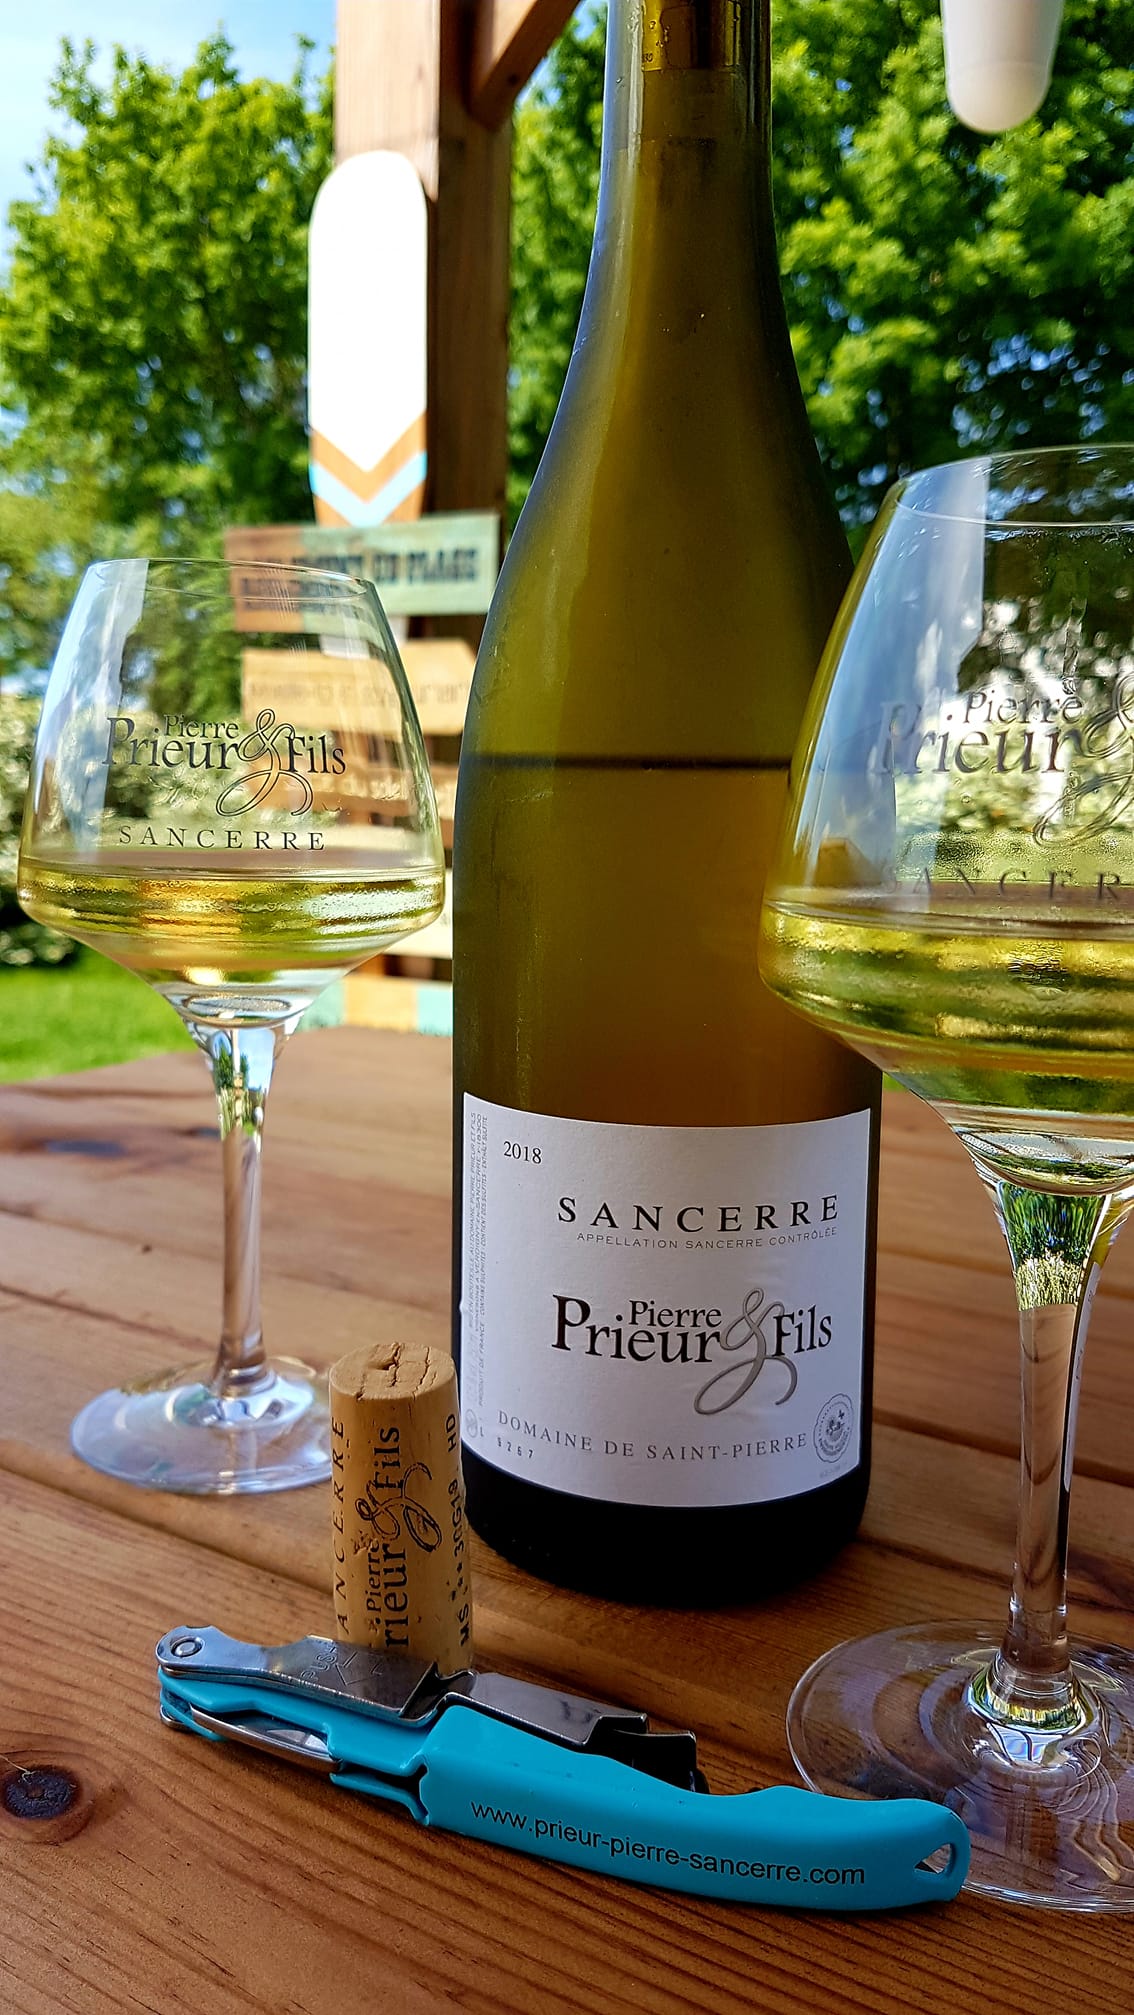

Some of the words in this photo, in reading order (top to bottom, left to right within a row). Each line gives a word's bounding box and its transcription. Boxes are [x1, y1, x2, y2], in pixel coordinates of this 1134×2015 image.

[164, 714, 239, 738] Pierre
[963, 689, 1083, 724] Pierre
[102, 717, 239, 769] Prieur
[216, 708, 313, 817] &
[285, 735, 346, 774] Fils
[119, 826, 325, 850] SANCERRE
[503, 1141, 542, 1164] 2018
[558, 1195, 838, 1233] SANCERRE
[577, 1232, 677, 1249] APPELLATION
[686, 1239, 762, 1249] SANCERRE
[769, 1227, 837, 1246] CONTRÔLÉE
[629, 1300, 721, 1328] Pierre
[551, 1294, 720, 1363] Prieur
[694, 1287, 798, 1415] &
[772, 1304, 832, 1357] Fils
[499, 1410, 592, 1451] DOMAINE
[604, 1440, 634, 1457] DE
[646, 1433, 807, 1460] SAINT-PIERRE
[373, 1427, 404, 1489] Fils
[331, 1417, 349, 1635] ANCERRE
[374, 1541, 409, 1648] rieur
[471, 1801, 865, 1885] www.prieur-pierre-sancerre.com
